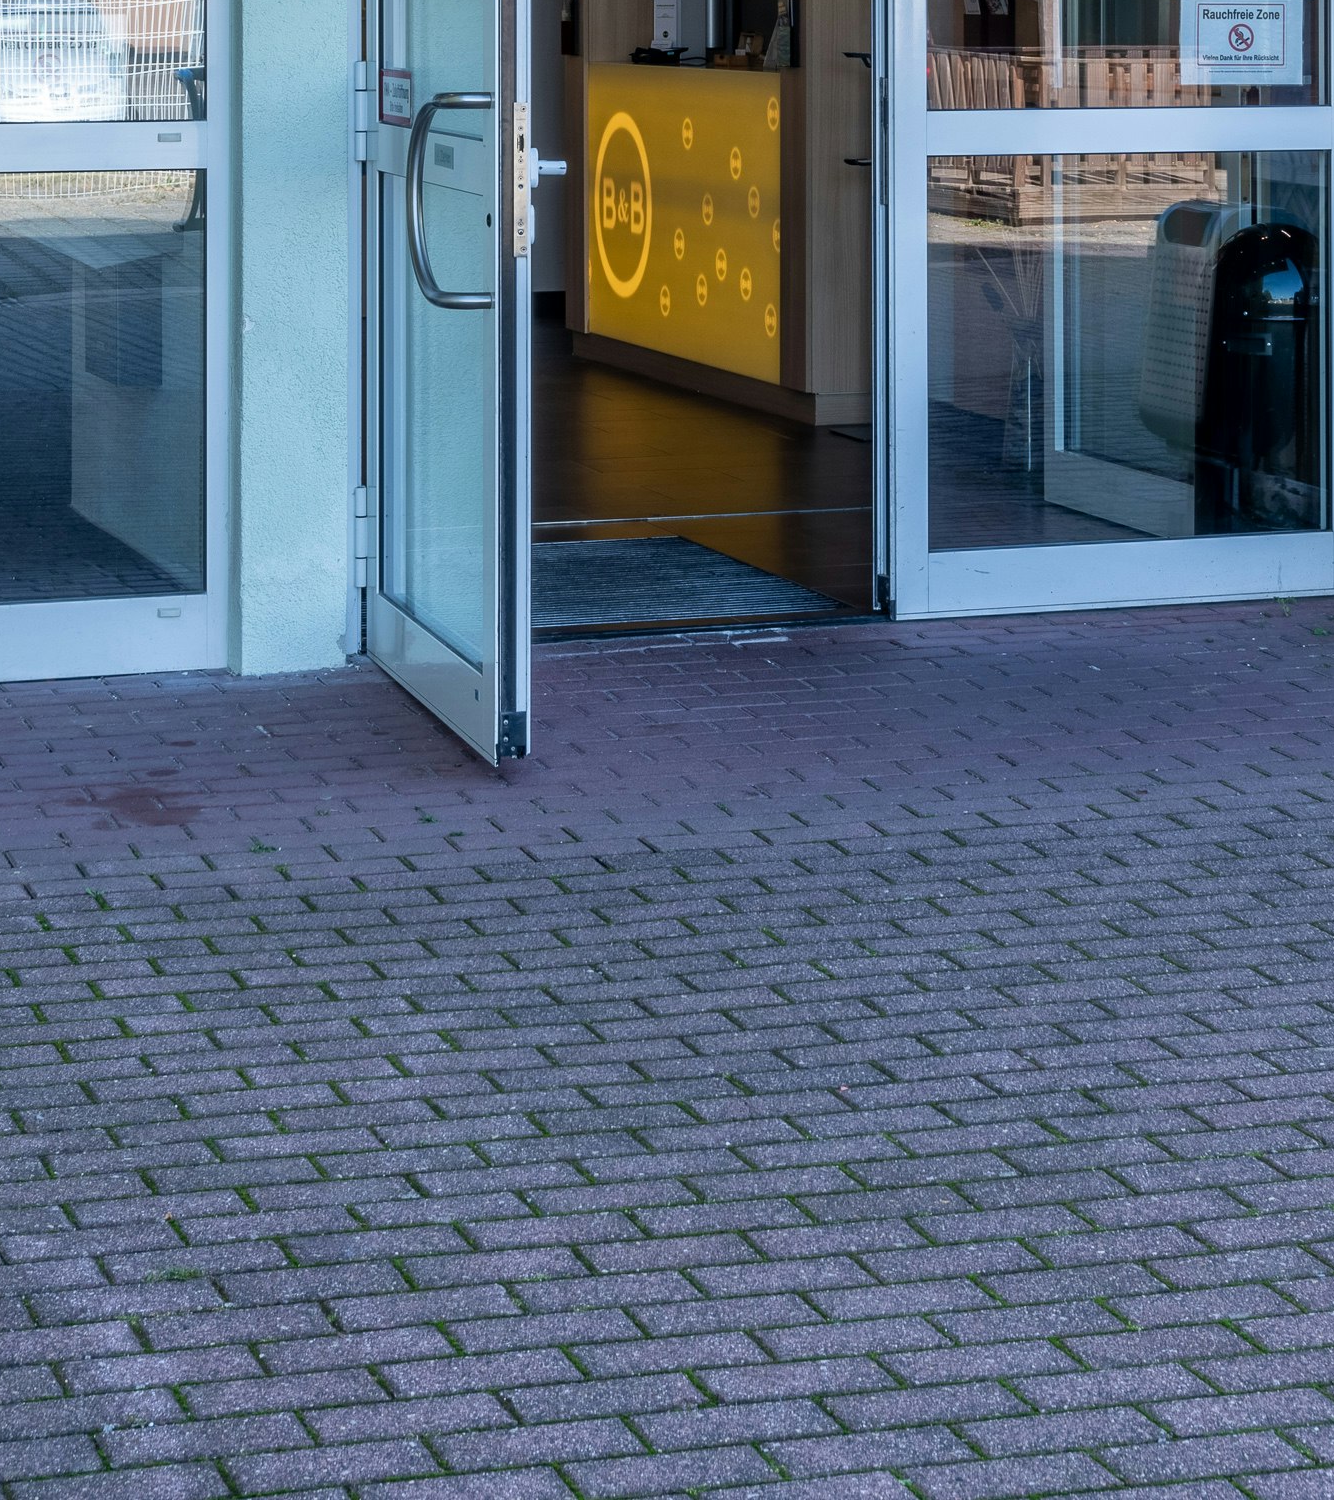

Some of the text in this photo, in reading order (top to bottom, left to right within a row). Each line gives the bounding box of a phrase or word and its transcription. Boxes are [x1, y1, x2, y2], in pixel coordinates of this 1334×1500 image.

[1202, 9, 1281, 20] Rauchfreie Zone
[603, 176, 645, 235] B&B
